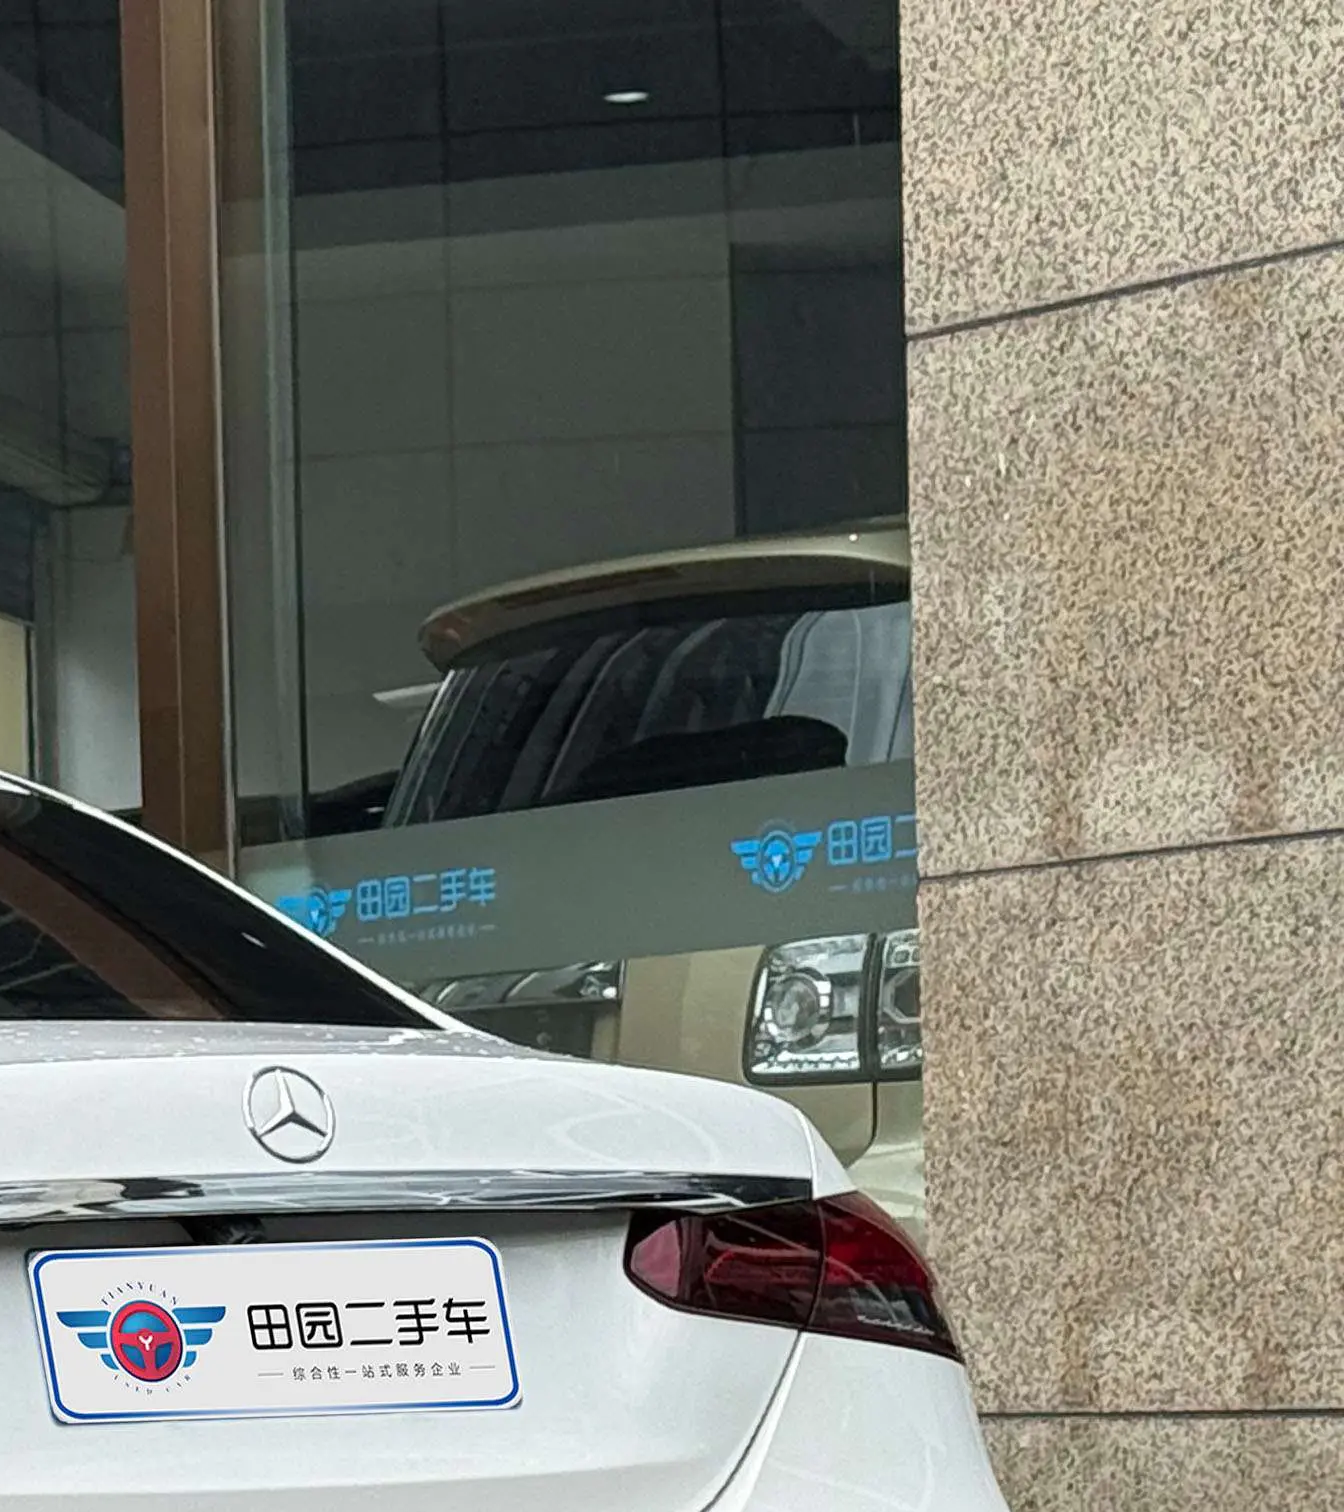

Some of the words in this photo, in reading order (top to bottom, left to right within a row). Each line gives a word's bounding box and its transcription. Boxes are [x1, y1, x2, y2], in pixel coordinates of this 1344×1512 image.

[357, 867, 496, 921] 田园二手车
